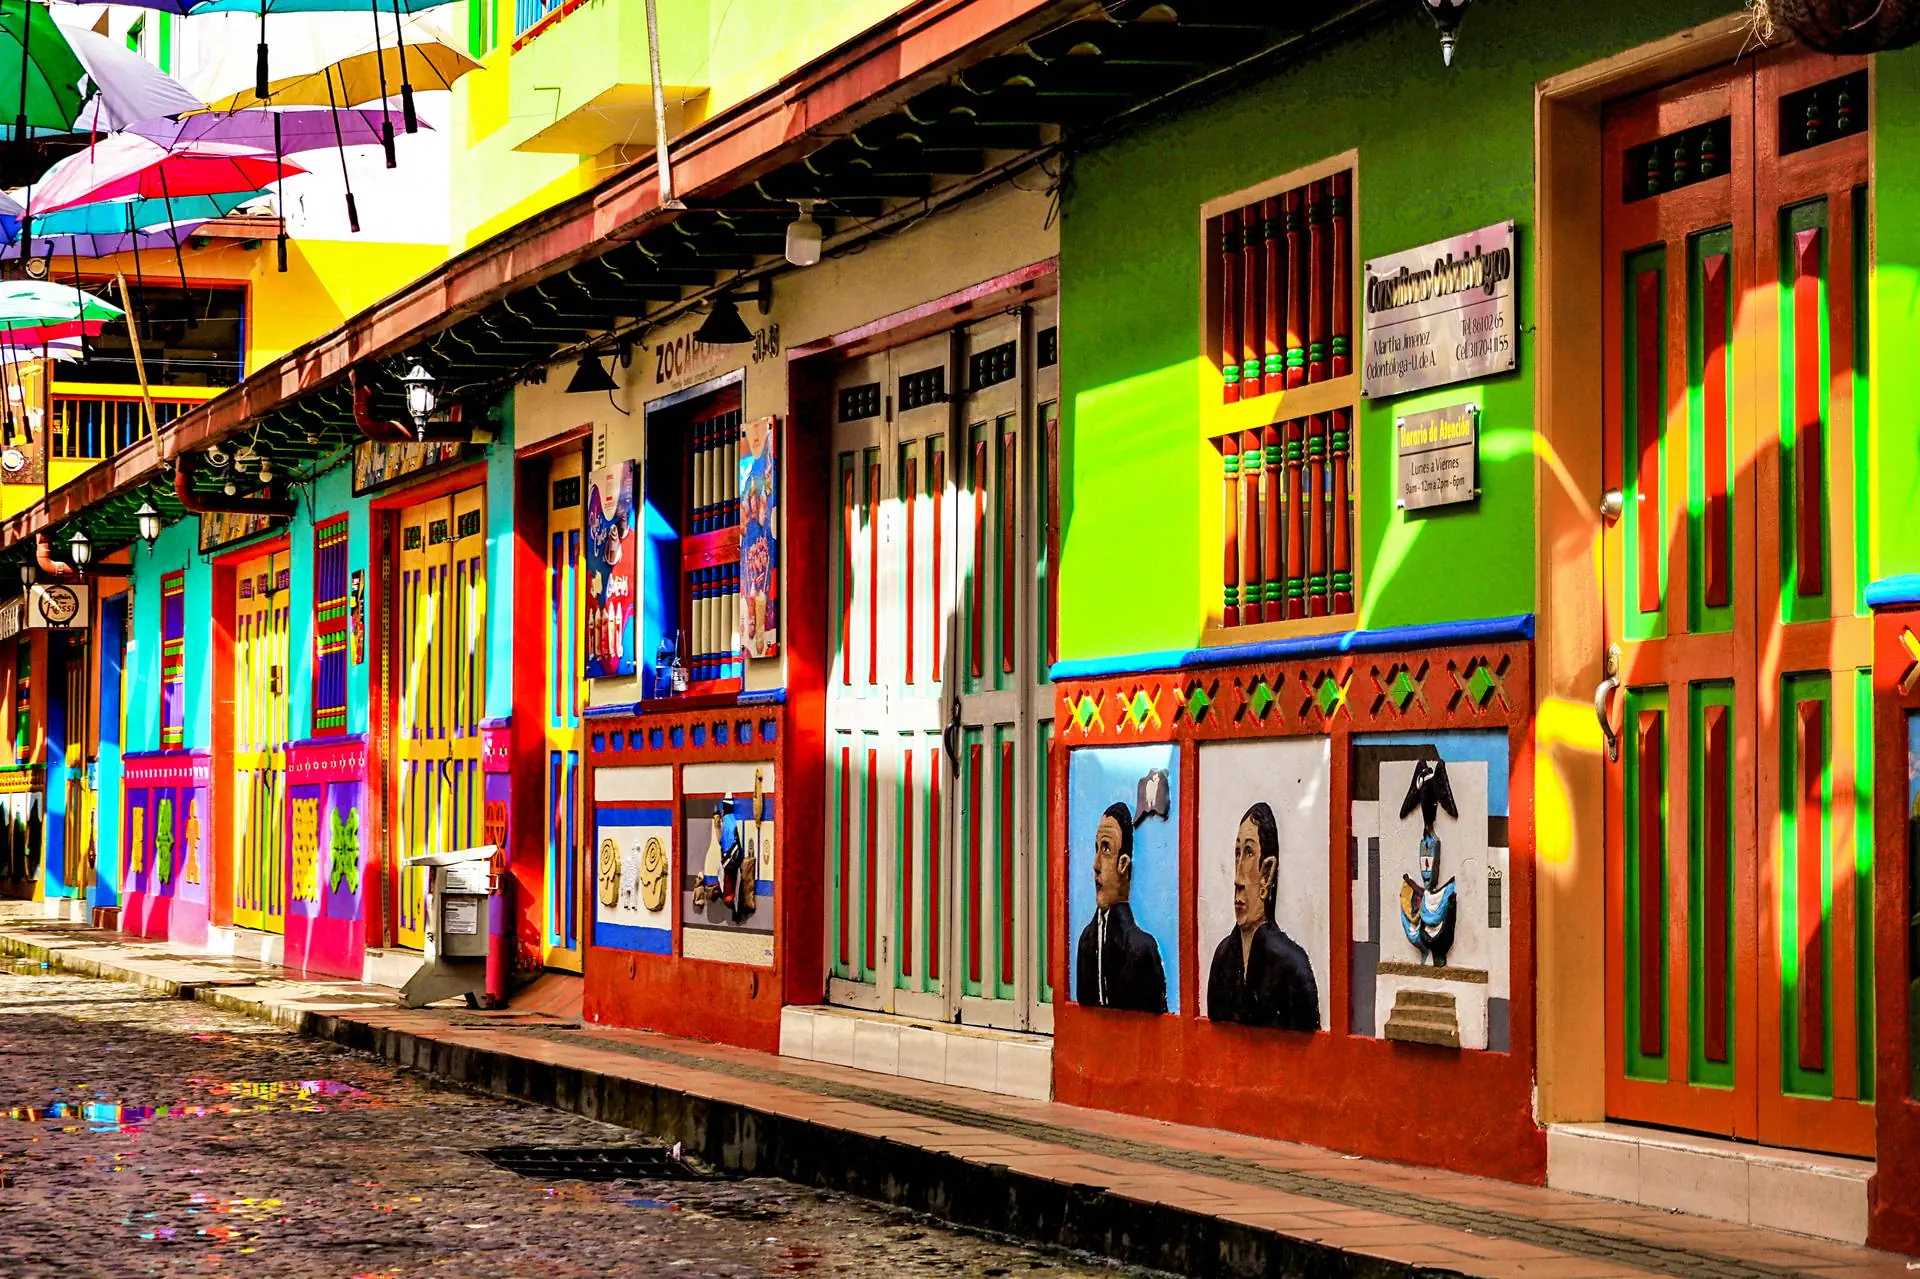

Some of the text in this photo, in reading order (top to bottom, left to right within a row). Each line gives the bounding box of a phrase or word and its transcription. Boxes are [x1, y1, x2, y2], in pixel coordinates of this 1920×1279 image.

[1374, 335, 1401, 357] Martha
[1419, 351, 1430, 369] de
[1401, 415, 1470, 448] Horario de Atención
[1411, 462, 1429, 475] Lunes
[1436, 458, 1459, 471] Viernes
